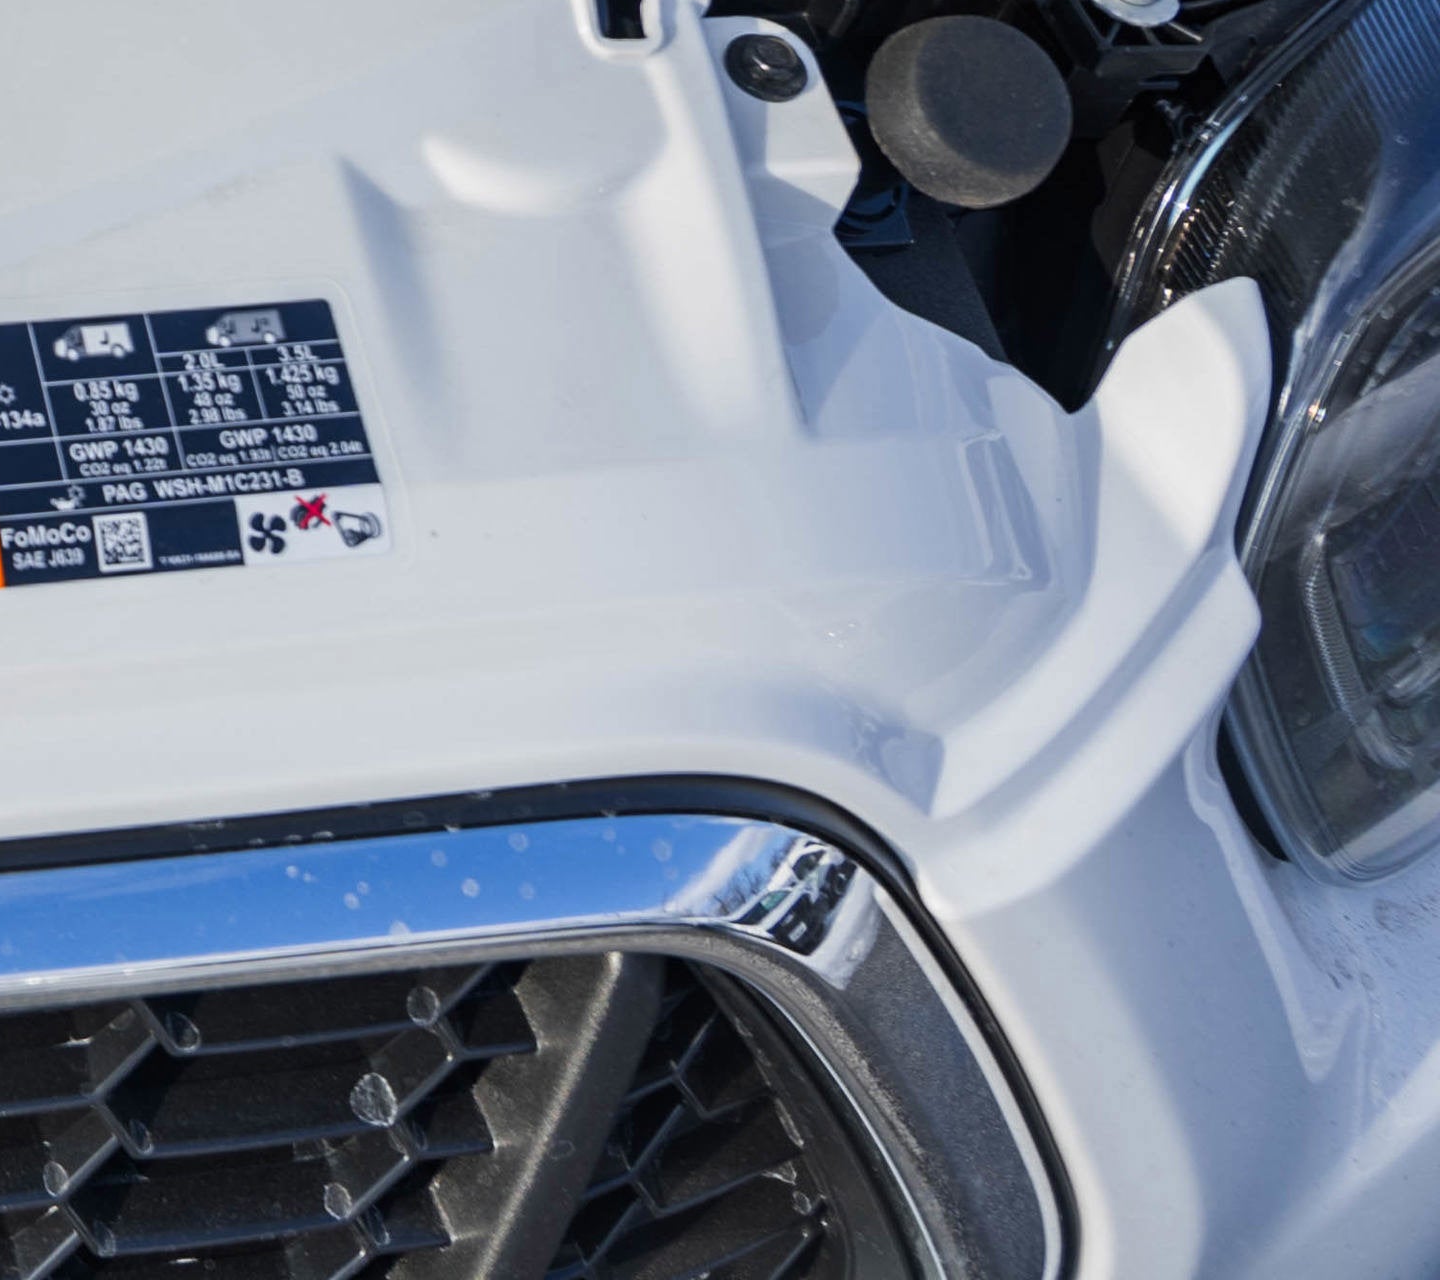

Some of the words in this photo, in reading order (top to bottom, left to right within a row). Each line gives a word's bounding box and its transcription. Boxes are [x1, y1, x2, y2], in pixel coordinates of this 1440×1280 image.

[182, 350, 225, 372] 2.0L
[277, 343, 318, 364] 3.5L
[177, 372, 216, 394] 1.35
[217, 370, 243, 394] kg
[265, 364, 313, 386] 1.425
[313, 362, 340, 387] kg
[73, 380, 112, 403] 0.85
[112, 377, 140, 404] kg
[214, 393, 234, 407] oz
[286, 383, 305, 401] 50
[307, 384, 327, 399] oz
[90, 399, 110, 417] 30
[111, 401, 131, 416] oz
[188, 406, 221, 425] 2.98
[223, 404, 248, 423] lbs
[281, 398, 313, 417] 3.14
[315, 397, 340, 415] lbs
[85, 416, 115, 434] 1.87
[118, 414, 144, 432] lbs
[218, 426, 269, 449] GWP
[272, 422, 318, 445] 1430
[68, 439, 119, 463] GWP
[122, 434, 170, 459] 1430
[278, 443, 309, 460] CO2
[310, 445, 329, 458] eq
[79, 461, 111, 478] CO2
[112, 462, 132, 476] eq
[186, 452, 216, 468] CO2
[219, 453, 238, 466] eq
[102, 481, 148, 504] PAG
[153, 468, 304, 501] WSH-M1C231-B
[0, 519, 93, 550] FoMoCo
[12, 550, 46, 571] SAE
[47, 546, 86, 568] J639
